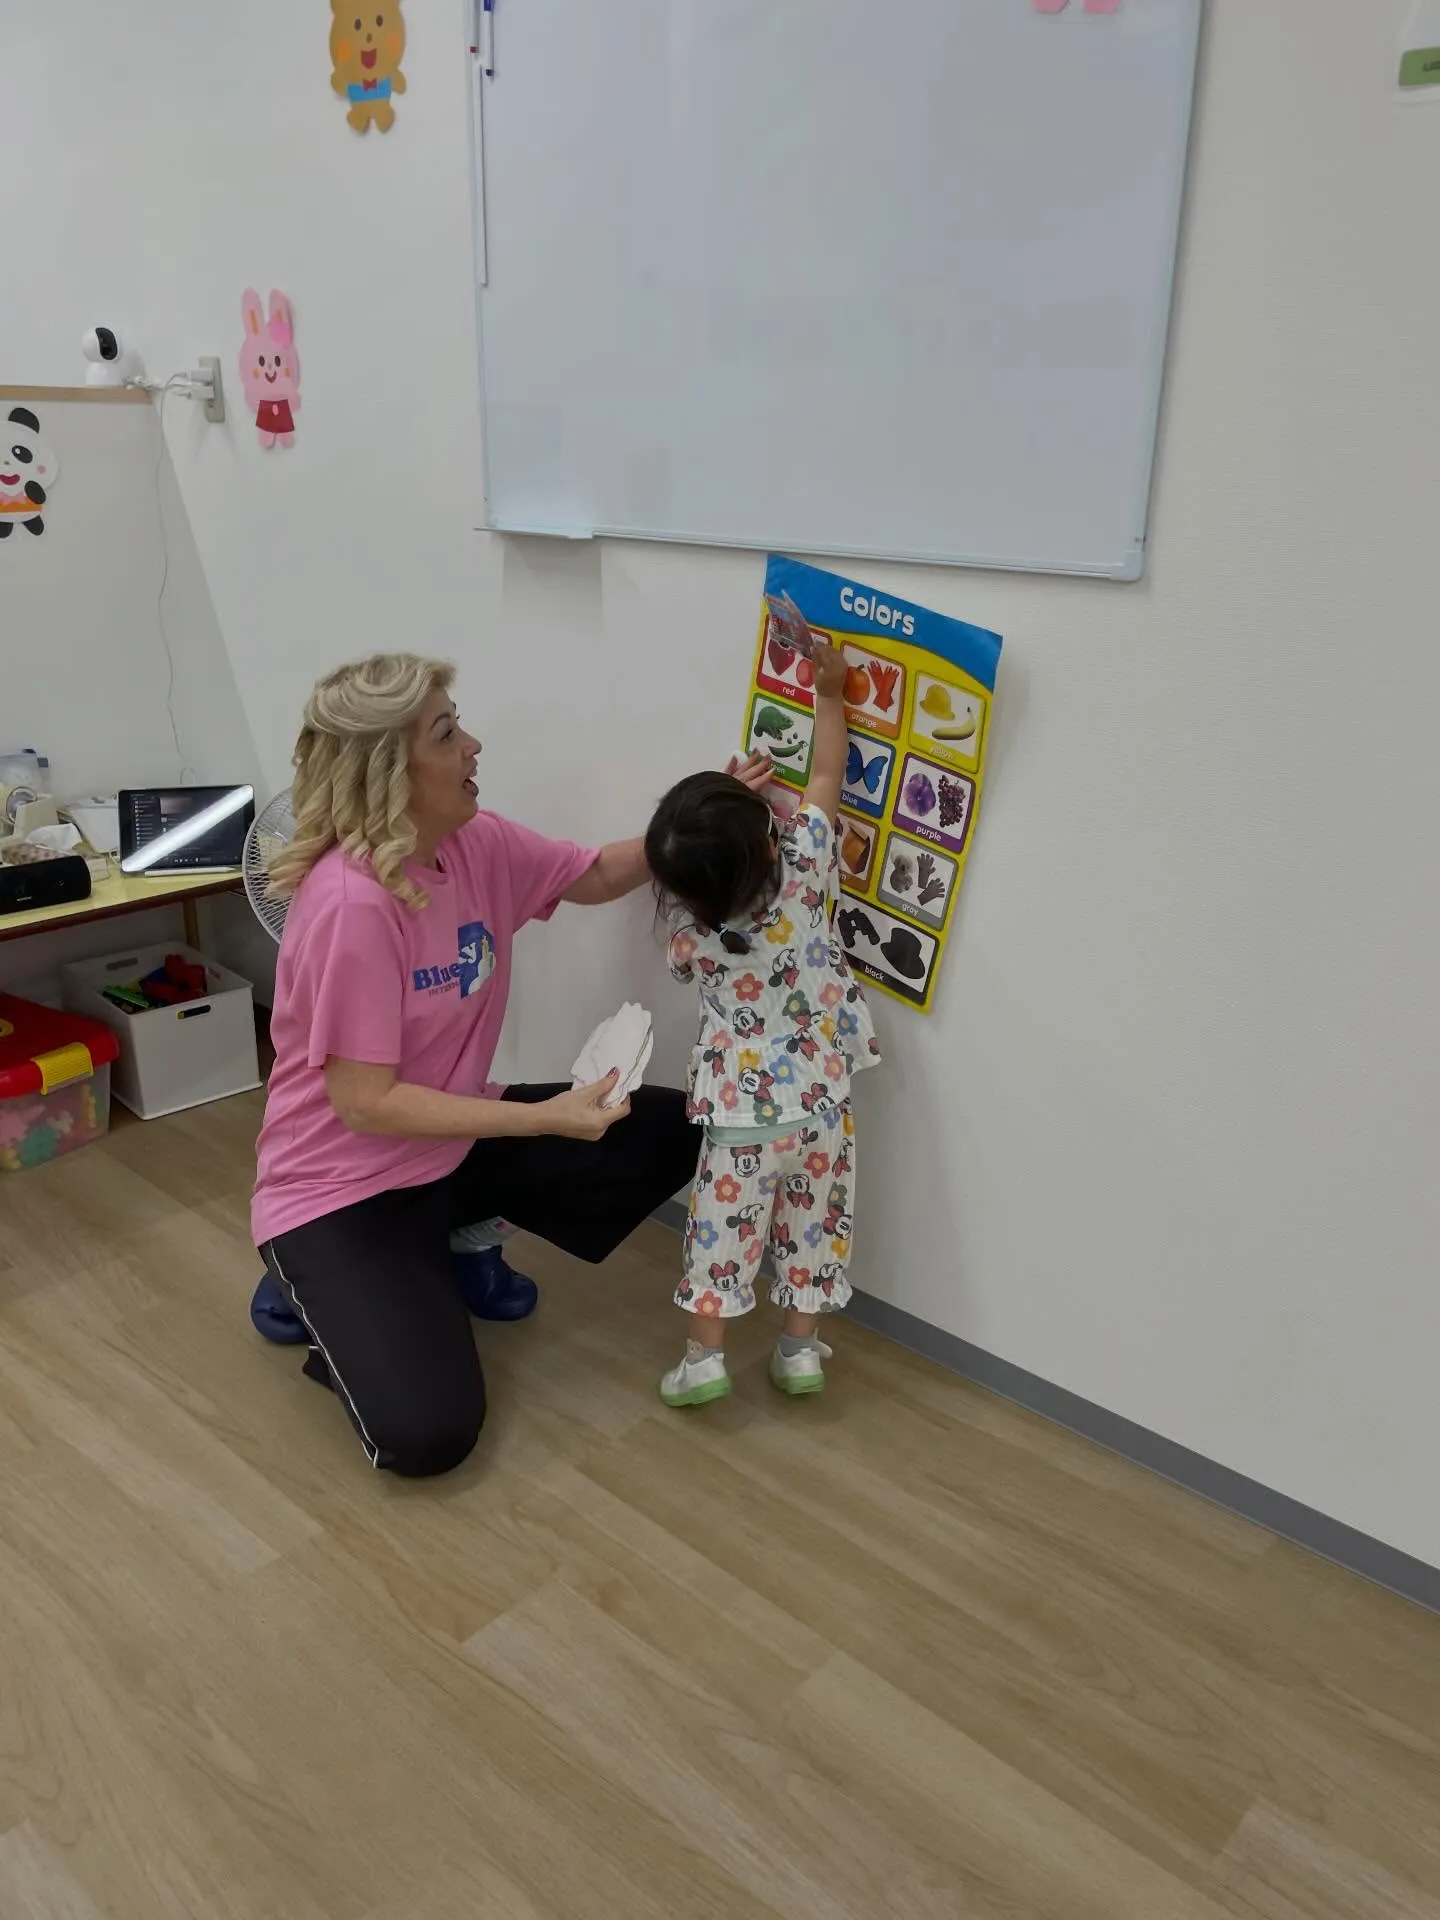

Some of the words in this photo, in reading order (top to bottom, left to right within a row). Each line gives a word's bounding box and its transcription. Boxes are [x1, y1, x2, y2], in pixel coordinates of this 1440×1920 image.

[840, 587, 915, 636] Colors
[782, 686, 796, 697] red
[851, 713, 877, 728] orange
[841, 793, 858, 806] blue
[916, 825, 942, 841] purple
[902, 903, 919, 916] gray
[413, 962, 460, 991] Blue
[864, 965, 885, 981] black
